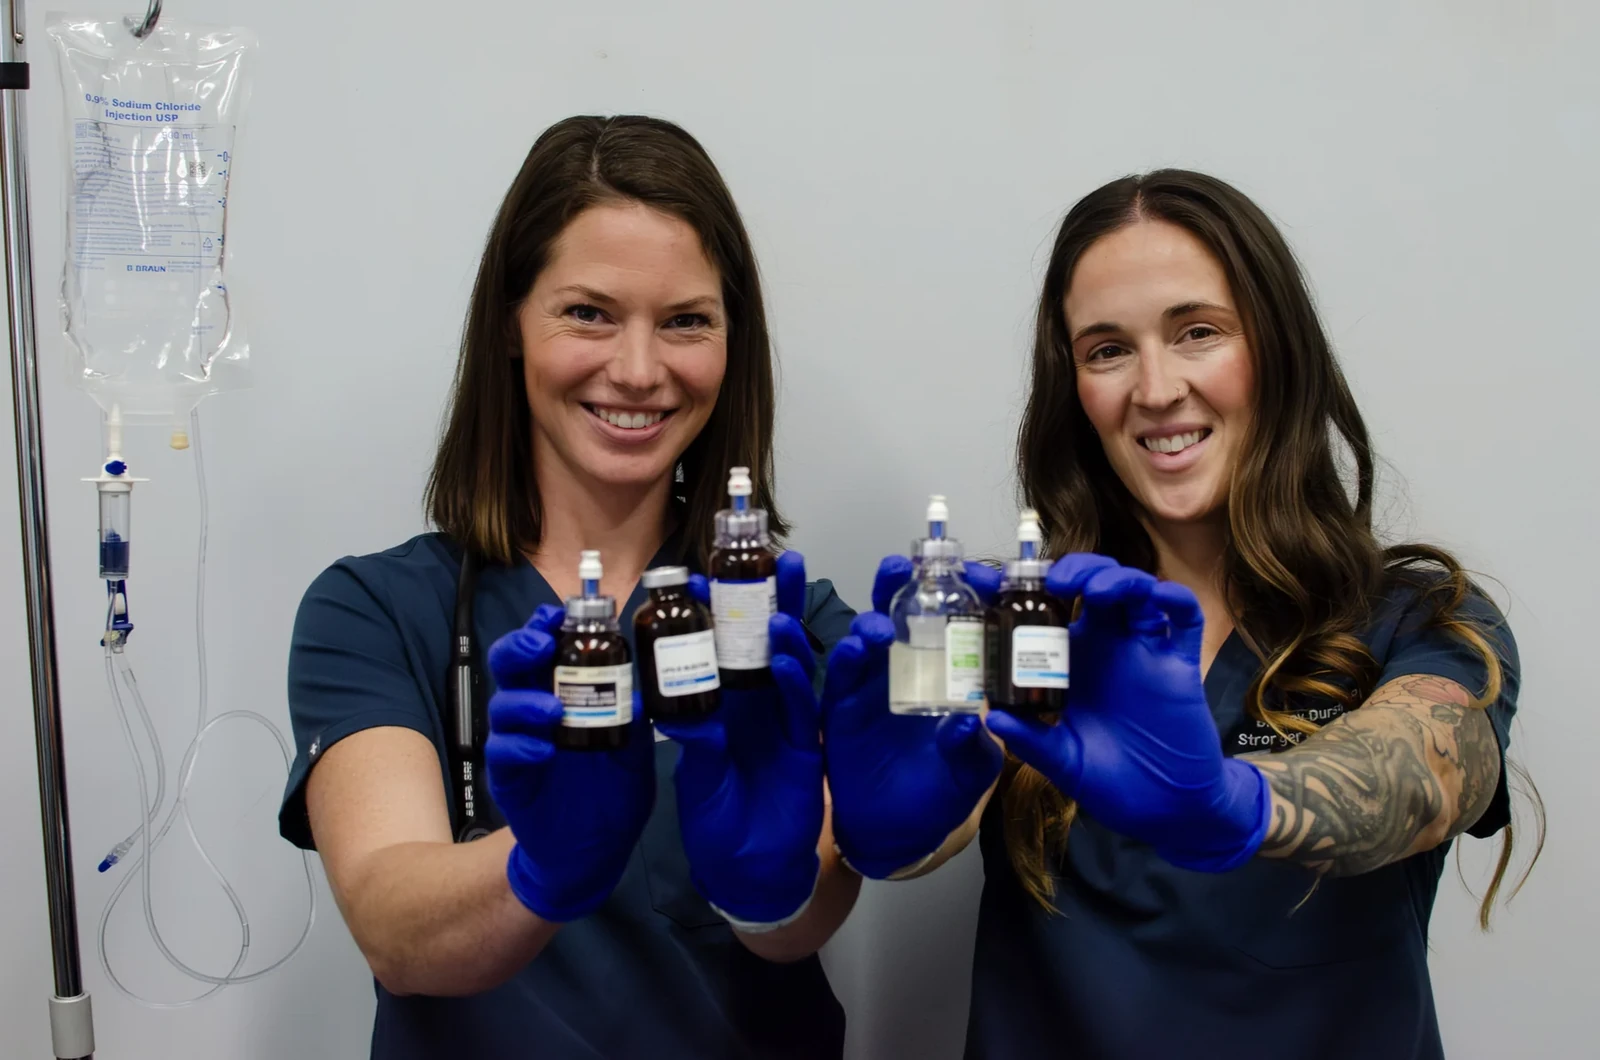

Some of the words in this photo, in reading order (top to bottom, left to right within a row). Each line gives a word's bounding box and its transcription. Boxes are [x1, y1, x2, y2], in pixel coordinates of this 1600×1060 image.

[85, 93, 109, 106] 0.9%
[112, 98, 151, 110] Sodium
[155, 101, 202, 111] Chloride
[105, 109, 152, 121] Injection
[156, 113, 179, 122] USP
[135, 264, 166, 272] BRAUN
